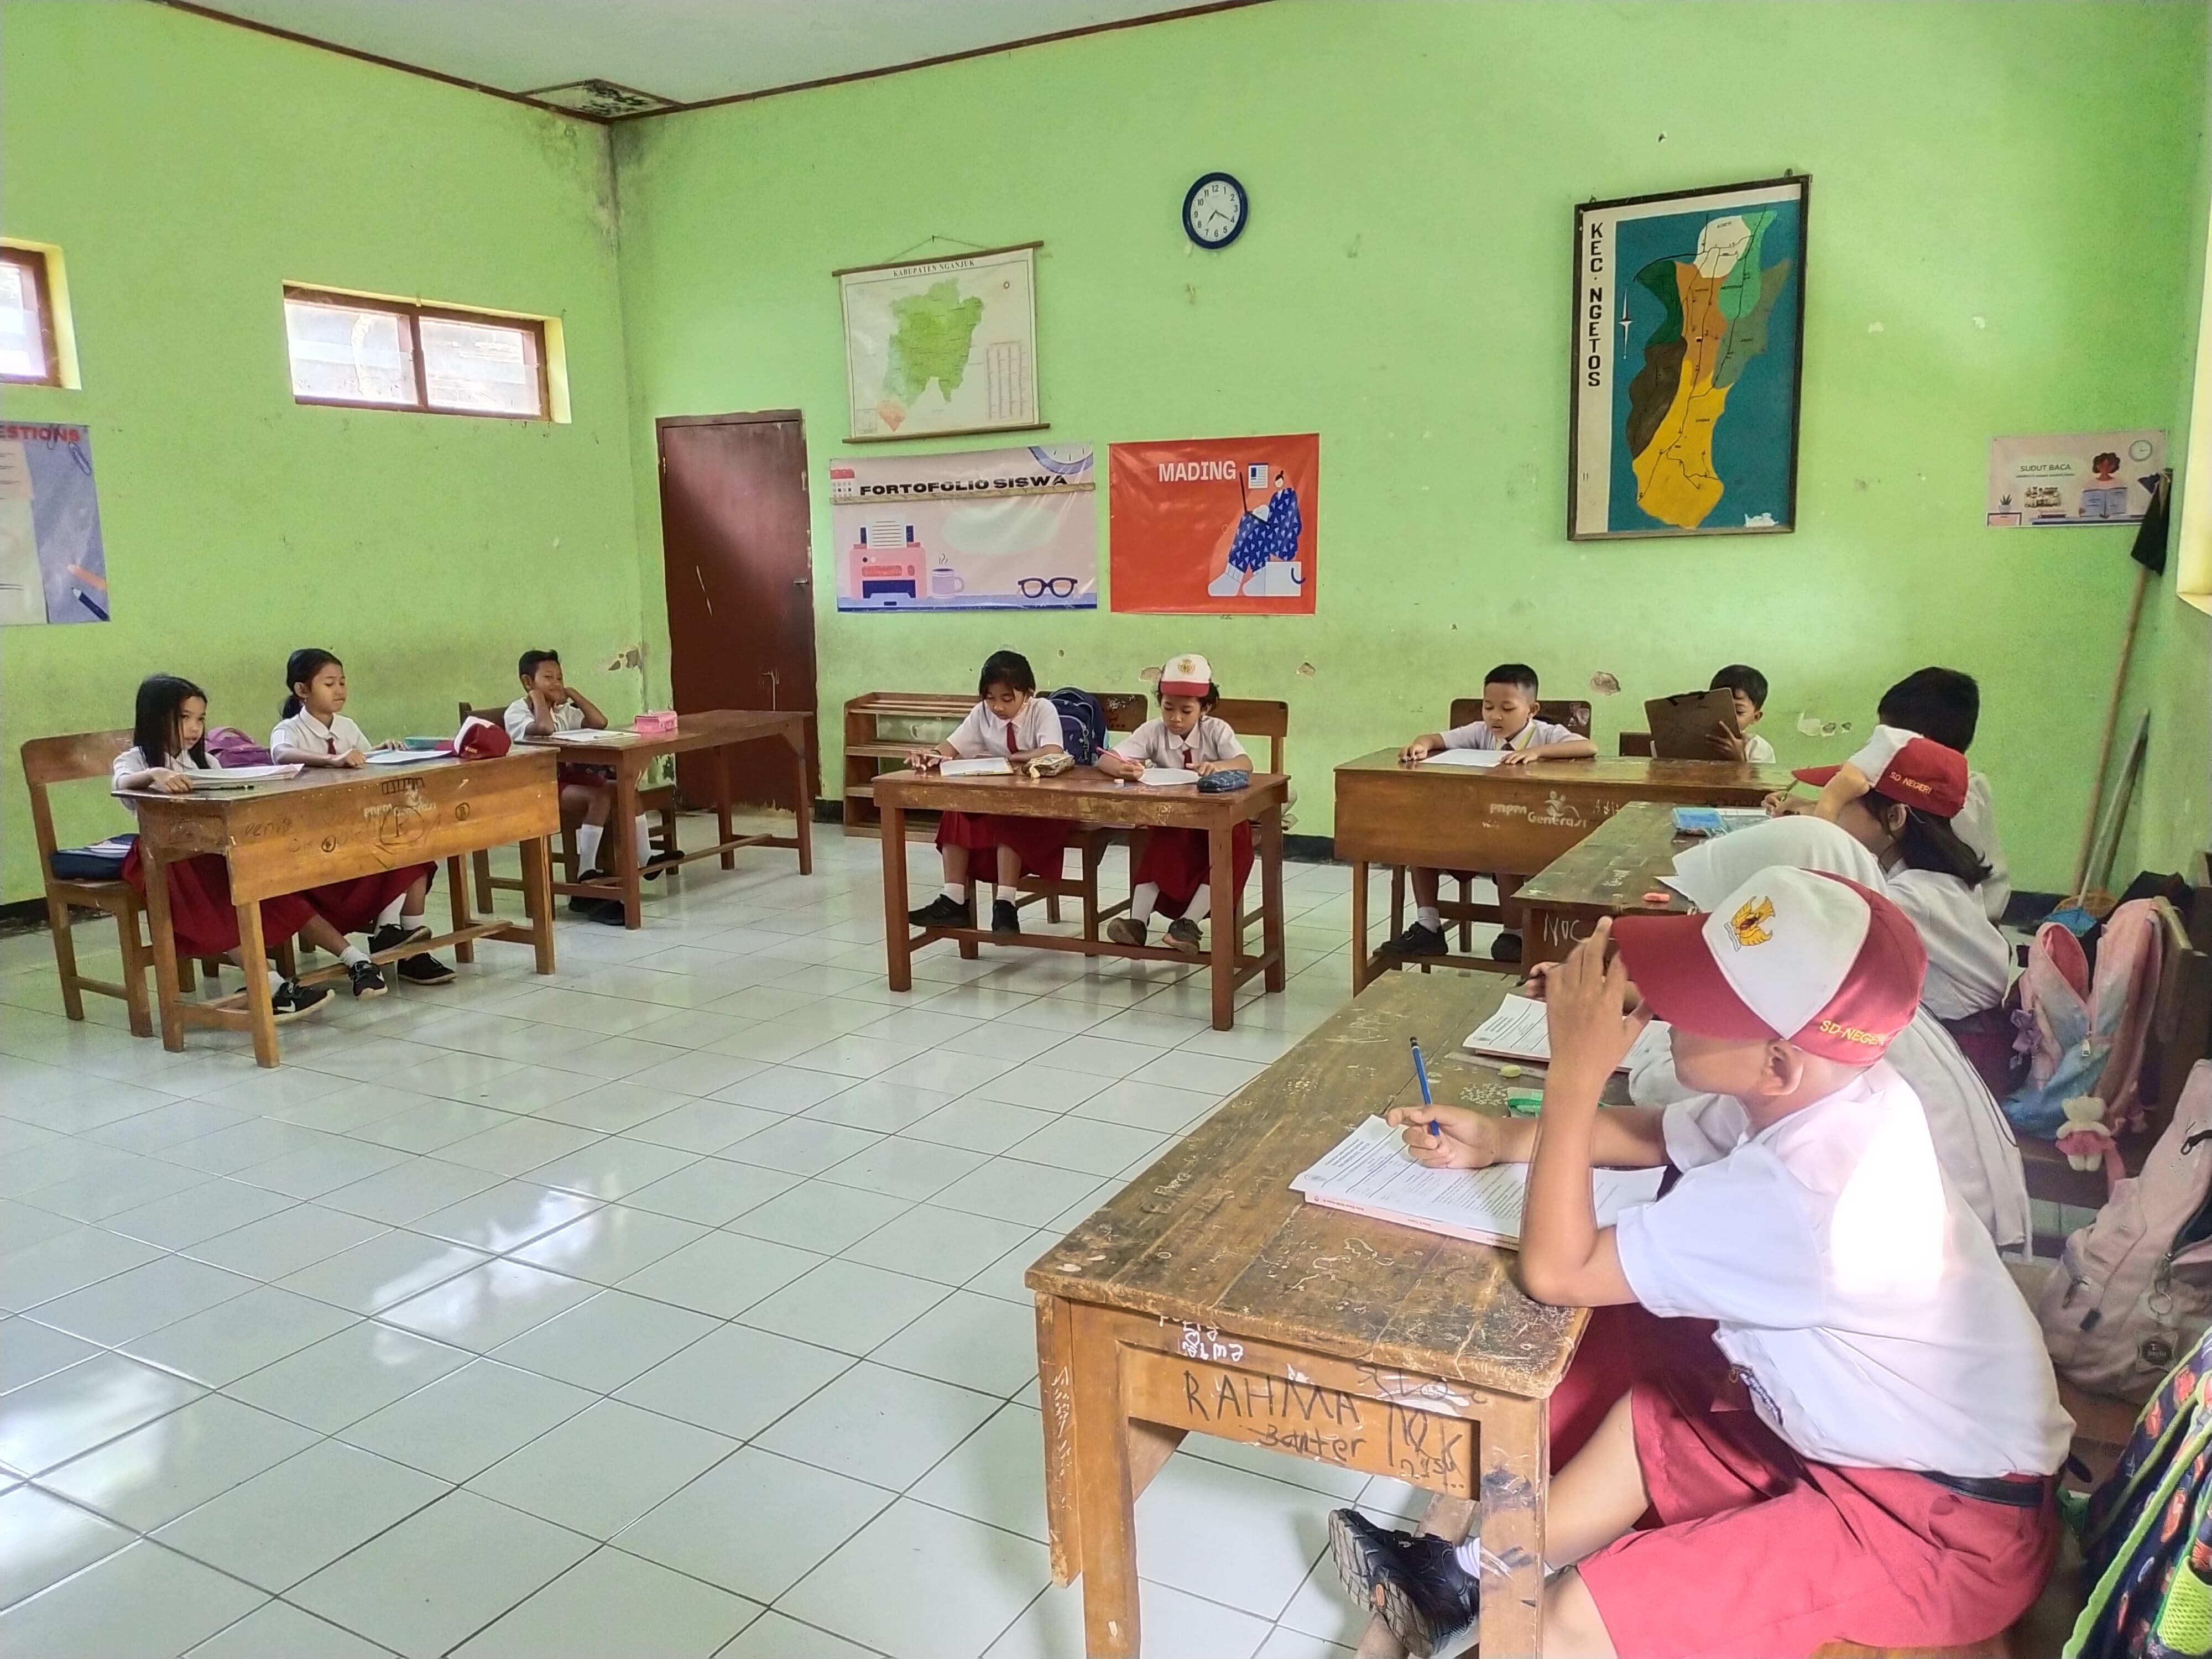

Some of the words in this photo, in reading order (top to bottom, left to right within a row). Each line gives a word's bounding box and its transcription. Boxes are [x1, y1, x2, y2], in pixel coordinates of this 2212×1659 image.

[893, 265, 937, 278] KABUPATEN
[939, 259, 975, 271] NGANJUK
[1588, 287, 1603, 387] NGETOS
[1159, 460, 1237, 482] MADING
[860, 478, 990, 496] FORTOFOLIO
[993, 474, 1068, 489] SISWA
[1889, 771, 1902, 782] SD
[1902, 777, 1933, 795] NEGERI
[1183, 1369, 1361, 1426] RAHMA
[1258, 1423, 1367, 1463] Banter
